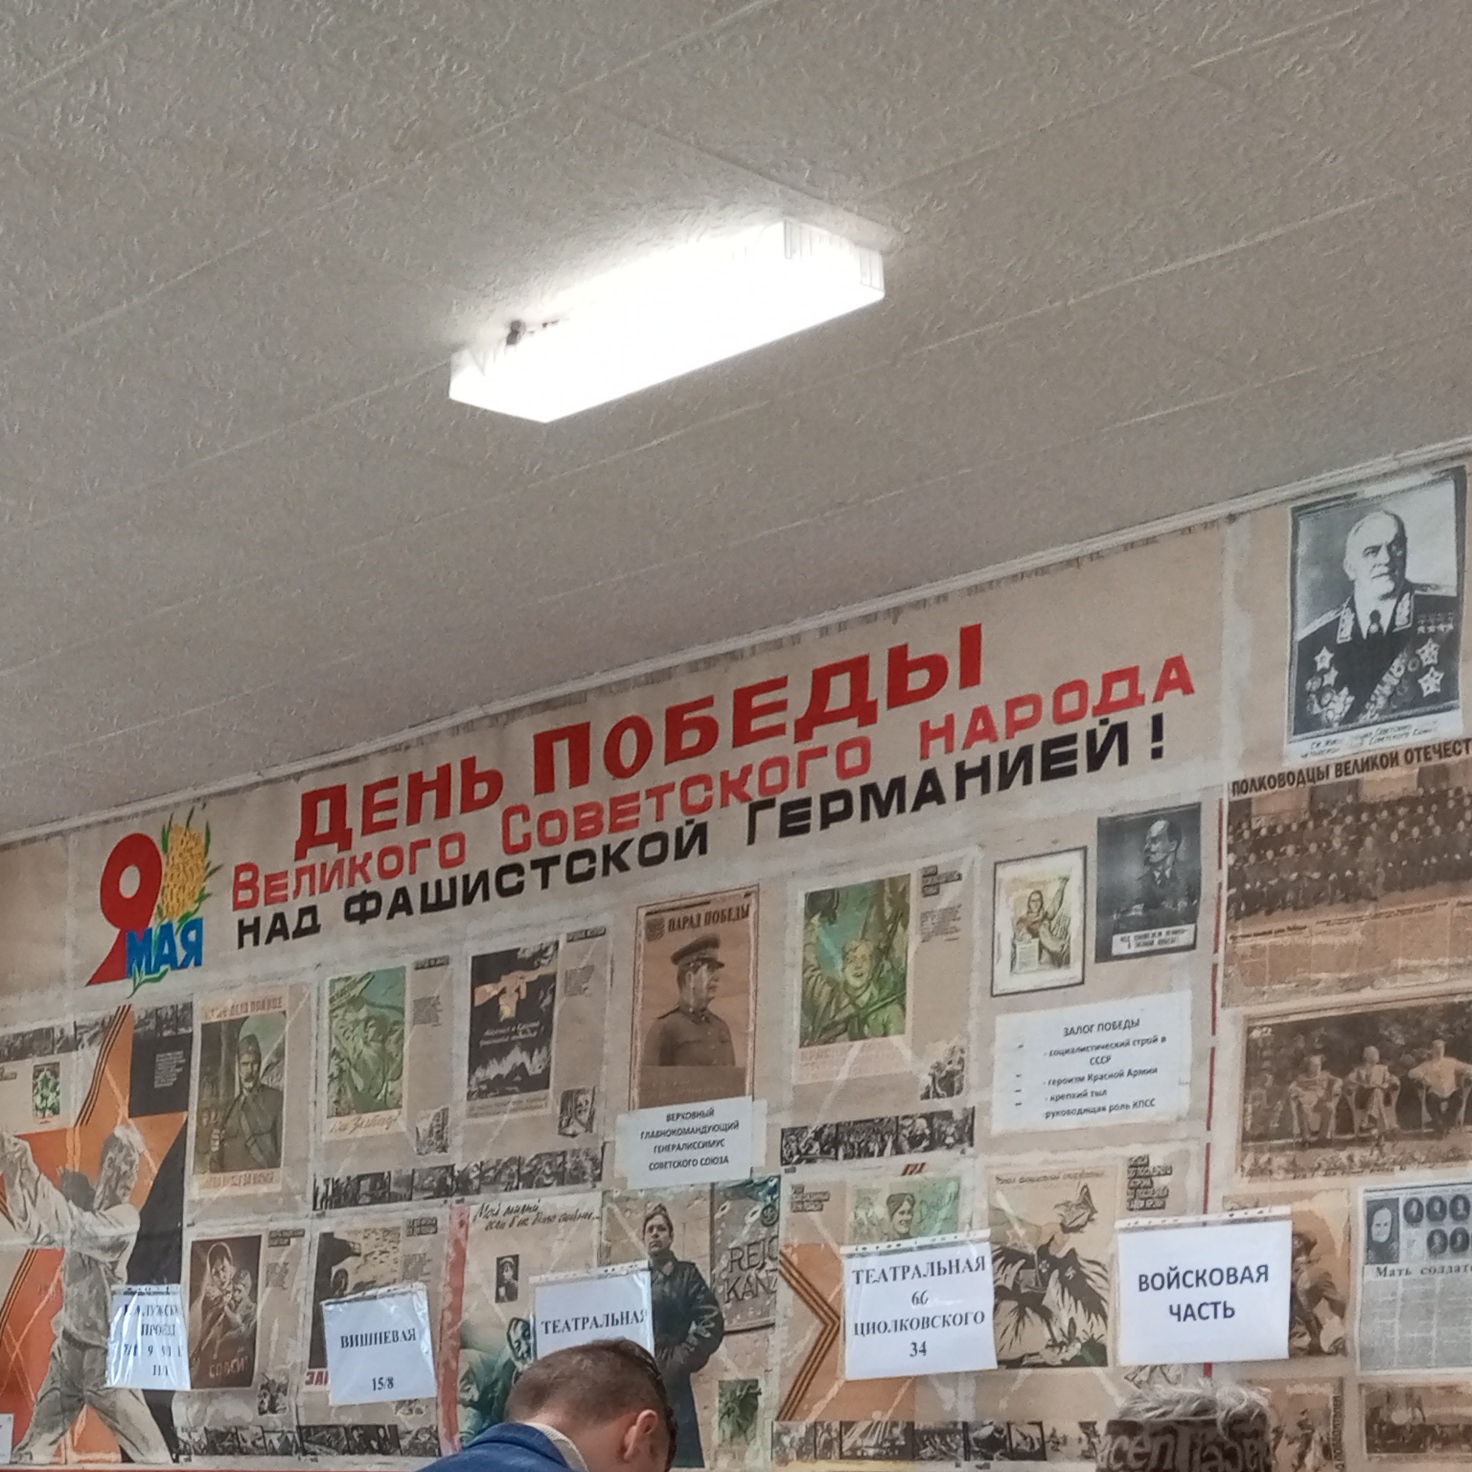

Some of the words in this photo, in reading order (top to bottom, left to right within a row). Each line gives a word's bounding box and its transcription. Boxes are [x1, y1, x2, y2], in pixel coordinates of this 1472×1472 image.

[920, 655, 1194, 760] НАРОДА
[294, 755, 504, 861] ДЕНЬ
[533, 623, 982, 796] ПОБЕДЫ
[1232, 764, 1329, 796] ПОЛКОВОДЦЫ
[1335, 752, 1399, 778] ВЕЛИКОЙ
[237, 909, 322, 949] НАД
[342, 821, 708, 925] ФАШИСТСКОЙ
[668, 912, 701, 933] ПАРАД
[704, 903, 750, 926] ПОБЕДЫ
[126, 917, 204, 980] МАЯ
[1063, 1023, 1095, 1037] ЗАЛОГ
[1097, 1018, 1140, 1032] ПОБЕДЫ
[1089, 1056, 1112, 1066] СССР
[1087, 1069, 1125, 1084] Красной
[1132, 1098, 1156, 1109] КПСС
[666, 1107, 715, 1122] ВЕРХОВНЫЙ
[640, 1120, 740, 1140] ГЛАВНОКОМАНДУЮЩИЙ
[653, 1138, 726, 1154] ГЕНЕРАЛИССИМУС
[648, 1158, 699, 1171] СОВЕТСКОГО
[700, 1156, 730, 1167] СОЮЗА
[852, 1256, 986, 1285] ТЕАТРАЛЬНАЯ
[1138, 1264, 1269, 1292] ВОЙСКОВАЯ
[1376, 1266, 1412, 1277] Мать
[540, 1309, 648, 1335] ТЕАТРАЛЬНАЯ
[1169, 1301, 1235, 1322] ЧАСТЬ
[854, 1310, 985, 1337] ЦИОЛКОВСКОГО
[340, 1328, 417, 1349] ВИШНЕВАЯ
[910, 1341, 927, 1357] 34
